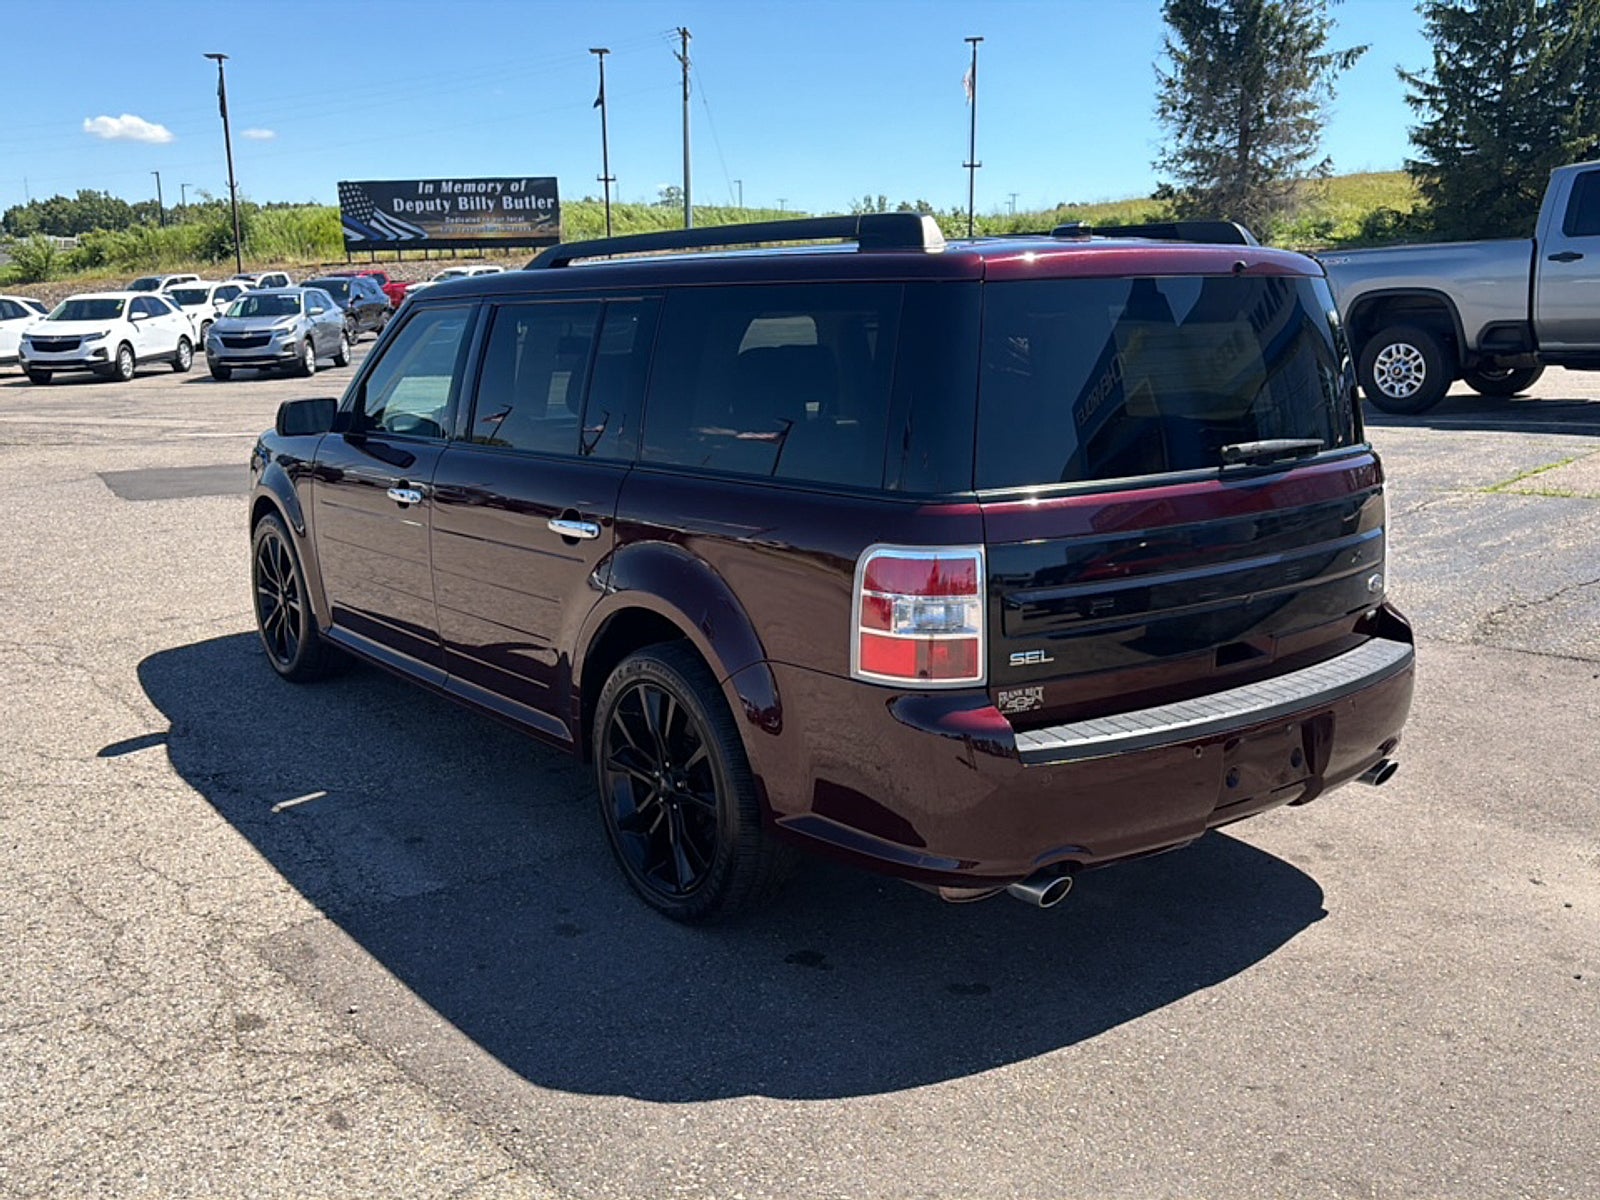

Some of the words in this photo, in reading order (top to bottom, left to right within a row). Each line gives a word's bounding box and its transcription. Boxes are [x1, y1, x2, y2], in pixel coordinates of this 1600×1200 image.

[418, 181, 434, 194] In
[440, 180, 504, 195] Memory
[510, 179, 527, 192] of
[393, 198, 451, 214] Deputy
[458, 196, 496, 212] Billy
[502, 194, 555, 210] Butler
[1010, 650, 1054, 666] SEL
